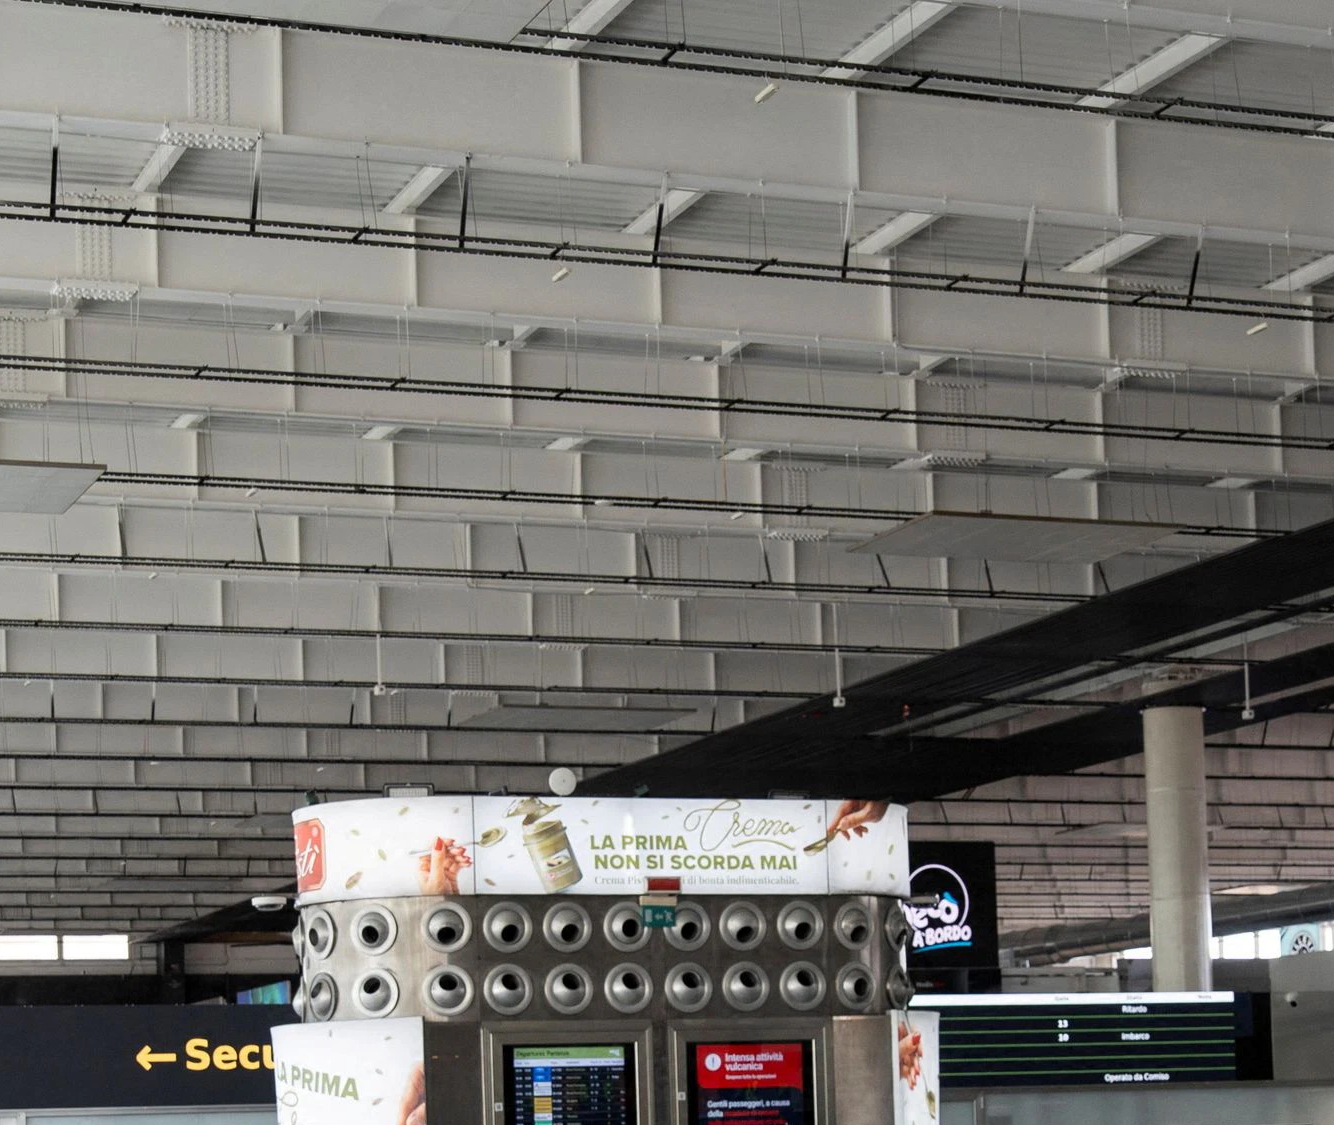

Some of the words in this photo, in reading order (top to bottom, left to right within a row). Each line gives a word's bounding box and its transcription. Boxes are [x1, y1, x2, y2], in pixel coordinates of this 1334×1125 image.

[590, 835, 615, 850] LA
[622, 835, 688, 850] PRIMA
[684, 799, 803, 852] Crema
[594, 854, 640, 870] NON
[646, 854, 664, 870] SI
[671, 854, 755, 870] SCORDA
[761, 855, 798, 870] MAI
[925, 925, 972, 945] BORDO
[1122, 1005, 1147, 1013] Ritardo
[1121, 1032, 1150, 1041] Imbarco
[291, 1065, 360, 1100] PRIMA
